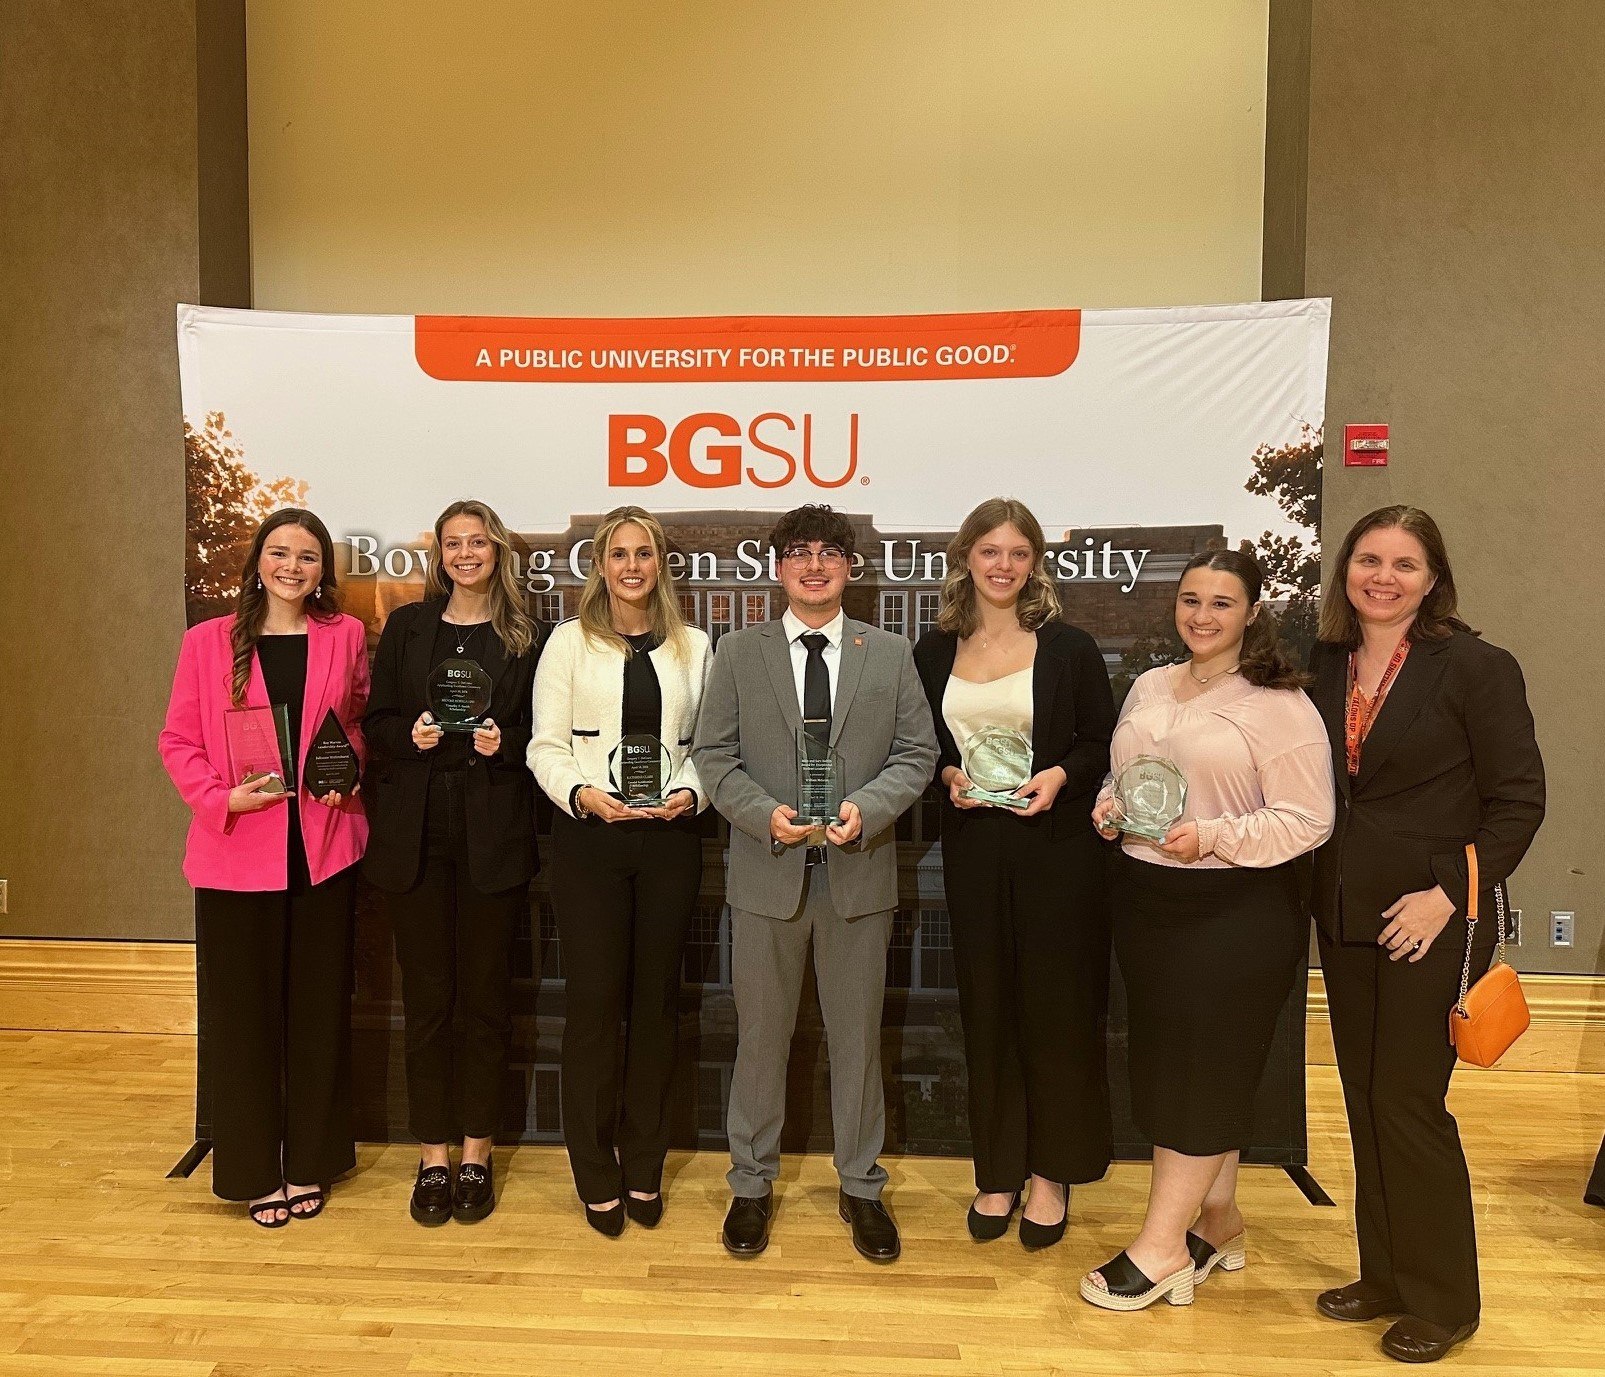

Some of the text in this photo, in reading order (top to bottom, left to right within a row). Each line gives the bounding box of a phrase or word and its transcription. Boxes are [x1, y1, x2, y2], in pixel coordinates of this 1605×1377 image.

[475, 348, 493, 367] A
[500, 349, 583, 368] PUBLIC
[590, 349, 732, 368] UNIVERSITY
[739, 348, 786, 367] FOR
[789, 348, 835, 367] THE
[843, 347, 928, 367] PUBLIC
[569, 538, 720, 581] Gen
[736, 539, 865, 582] Ste
[447, 669, 471, 679] BGSU
[627, 745, 650, 754] BGSU
